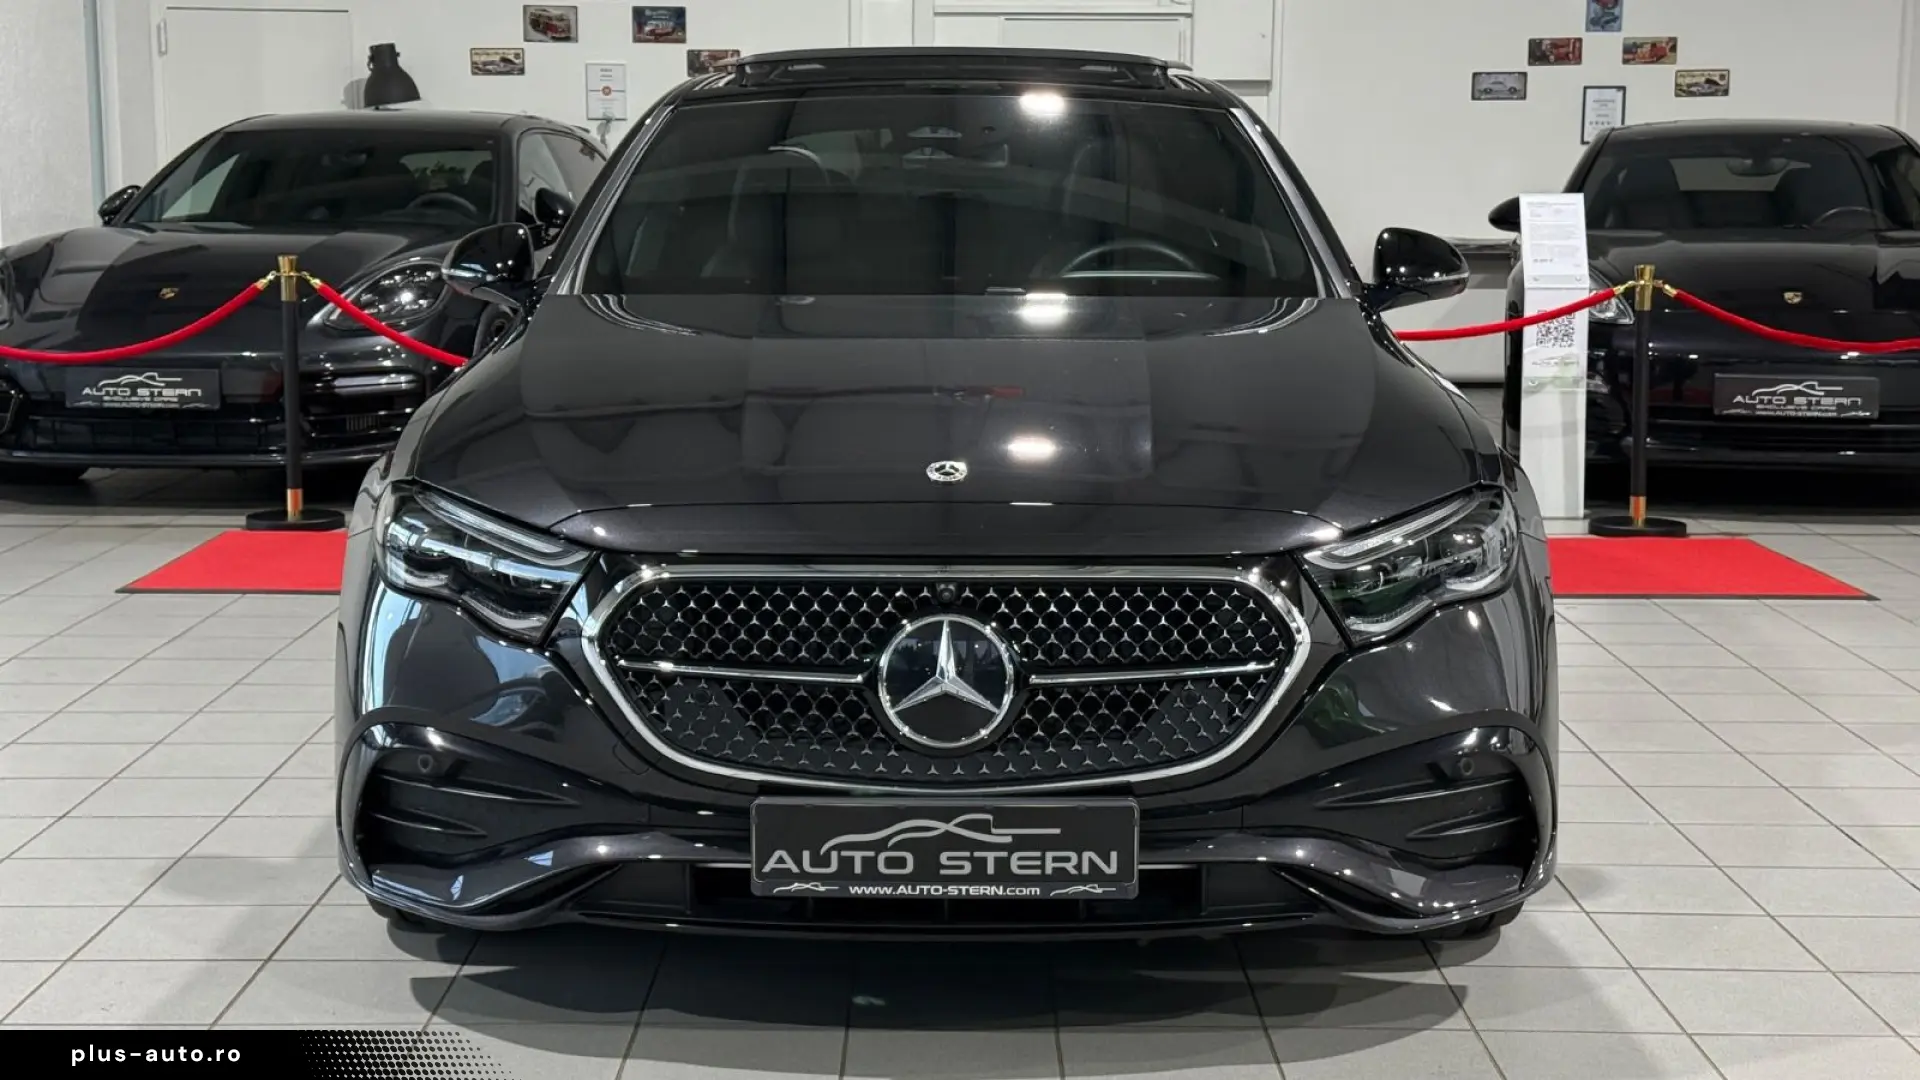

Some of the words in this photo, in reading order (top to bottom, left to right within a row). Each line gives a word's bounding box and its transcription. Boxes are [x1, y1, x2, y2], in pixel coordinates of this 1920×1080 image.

[82, 387, 131, 396] AUTO
[137, 388, 202, 397] STERN
[1732, 395, 1787, 404] AUTO
[1793, 396, 1862, 405] STERN
[761, 849, 914, 875] AUTO
[938, 850, 1118, 876] STERN
[848, 883, 1041, 897] www.AUTO-STERN.com
